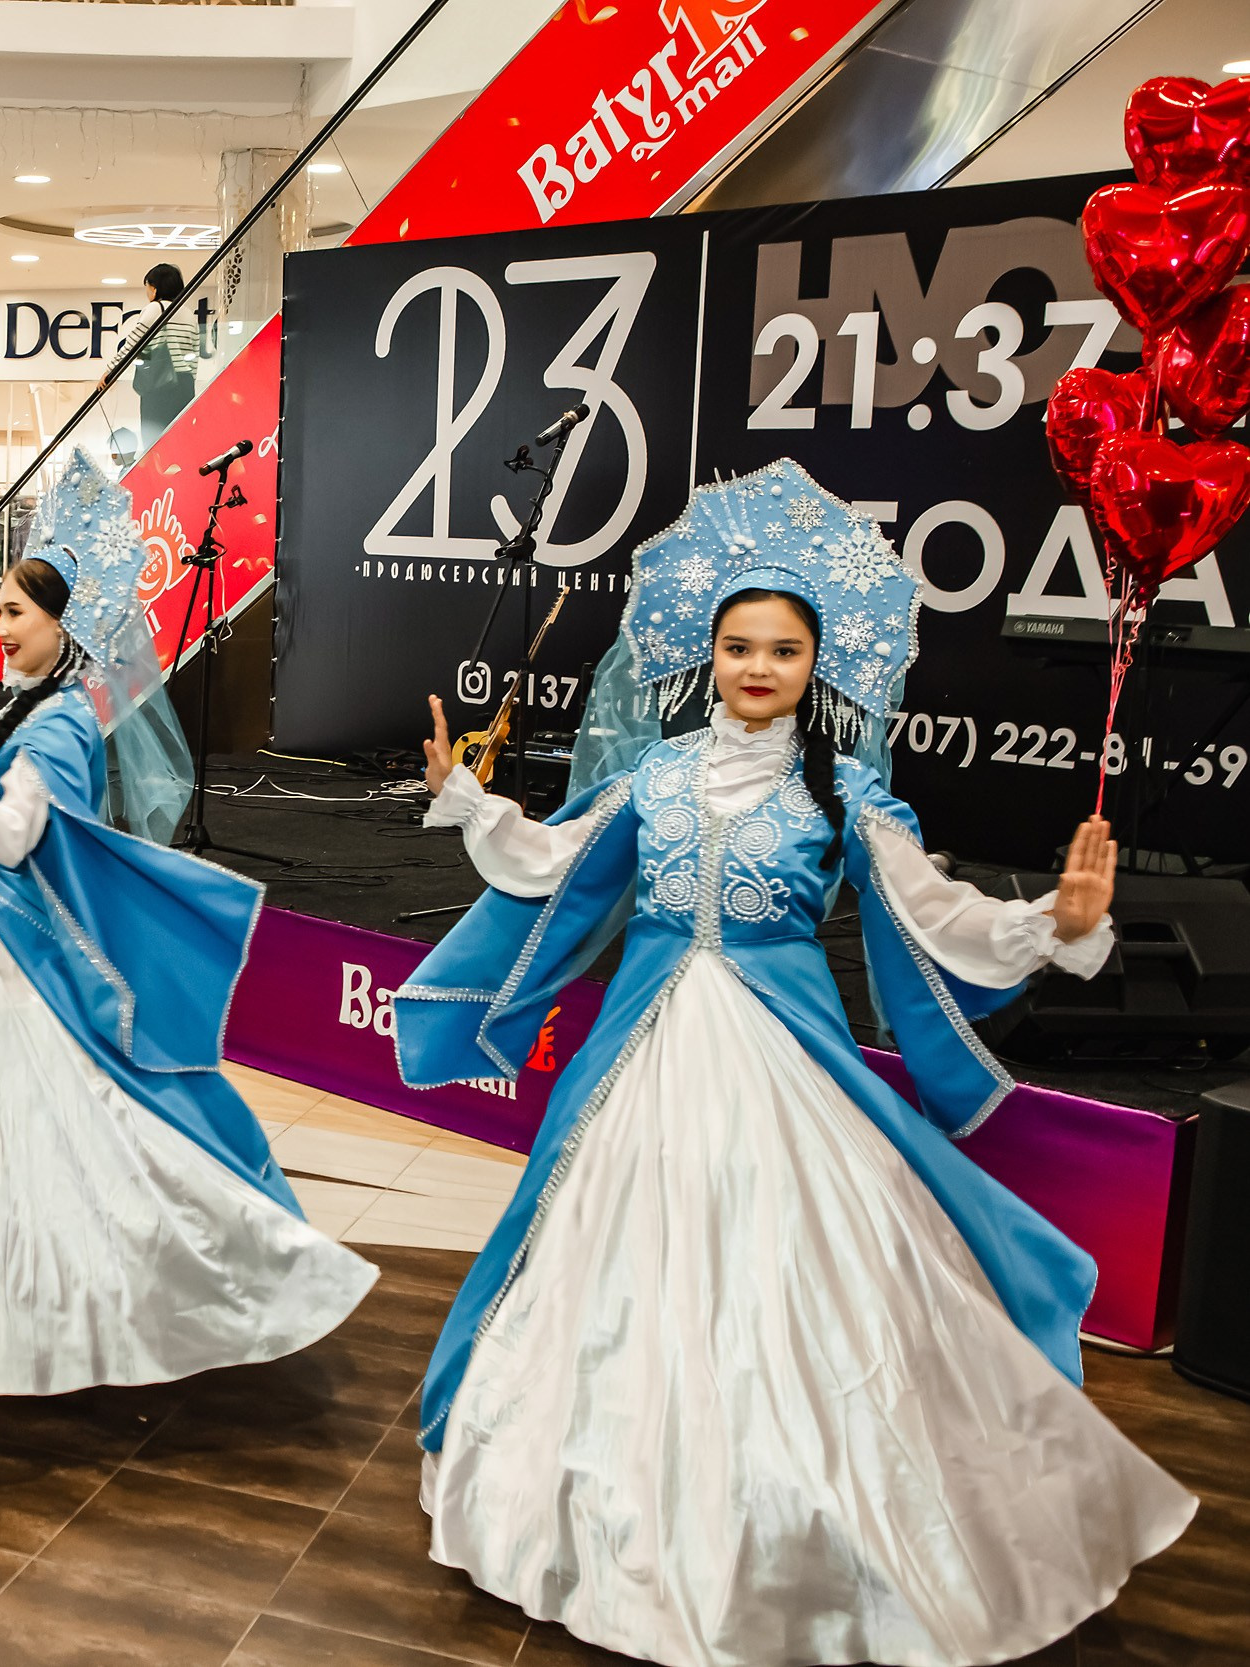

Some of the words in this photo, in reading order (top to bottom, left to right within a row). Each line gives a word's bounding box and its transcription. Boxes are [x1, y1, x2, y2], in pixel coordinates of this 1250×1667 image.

[517, 38, 683, 224] Batyr
[674, 24, 768, 125] mall
[363, 251, 658, 568] 23
[1026, 622, 1065, 635] YAMAHA
